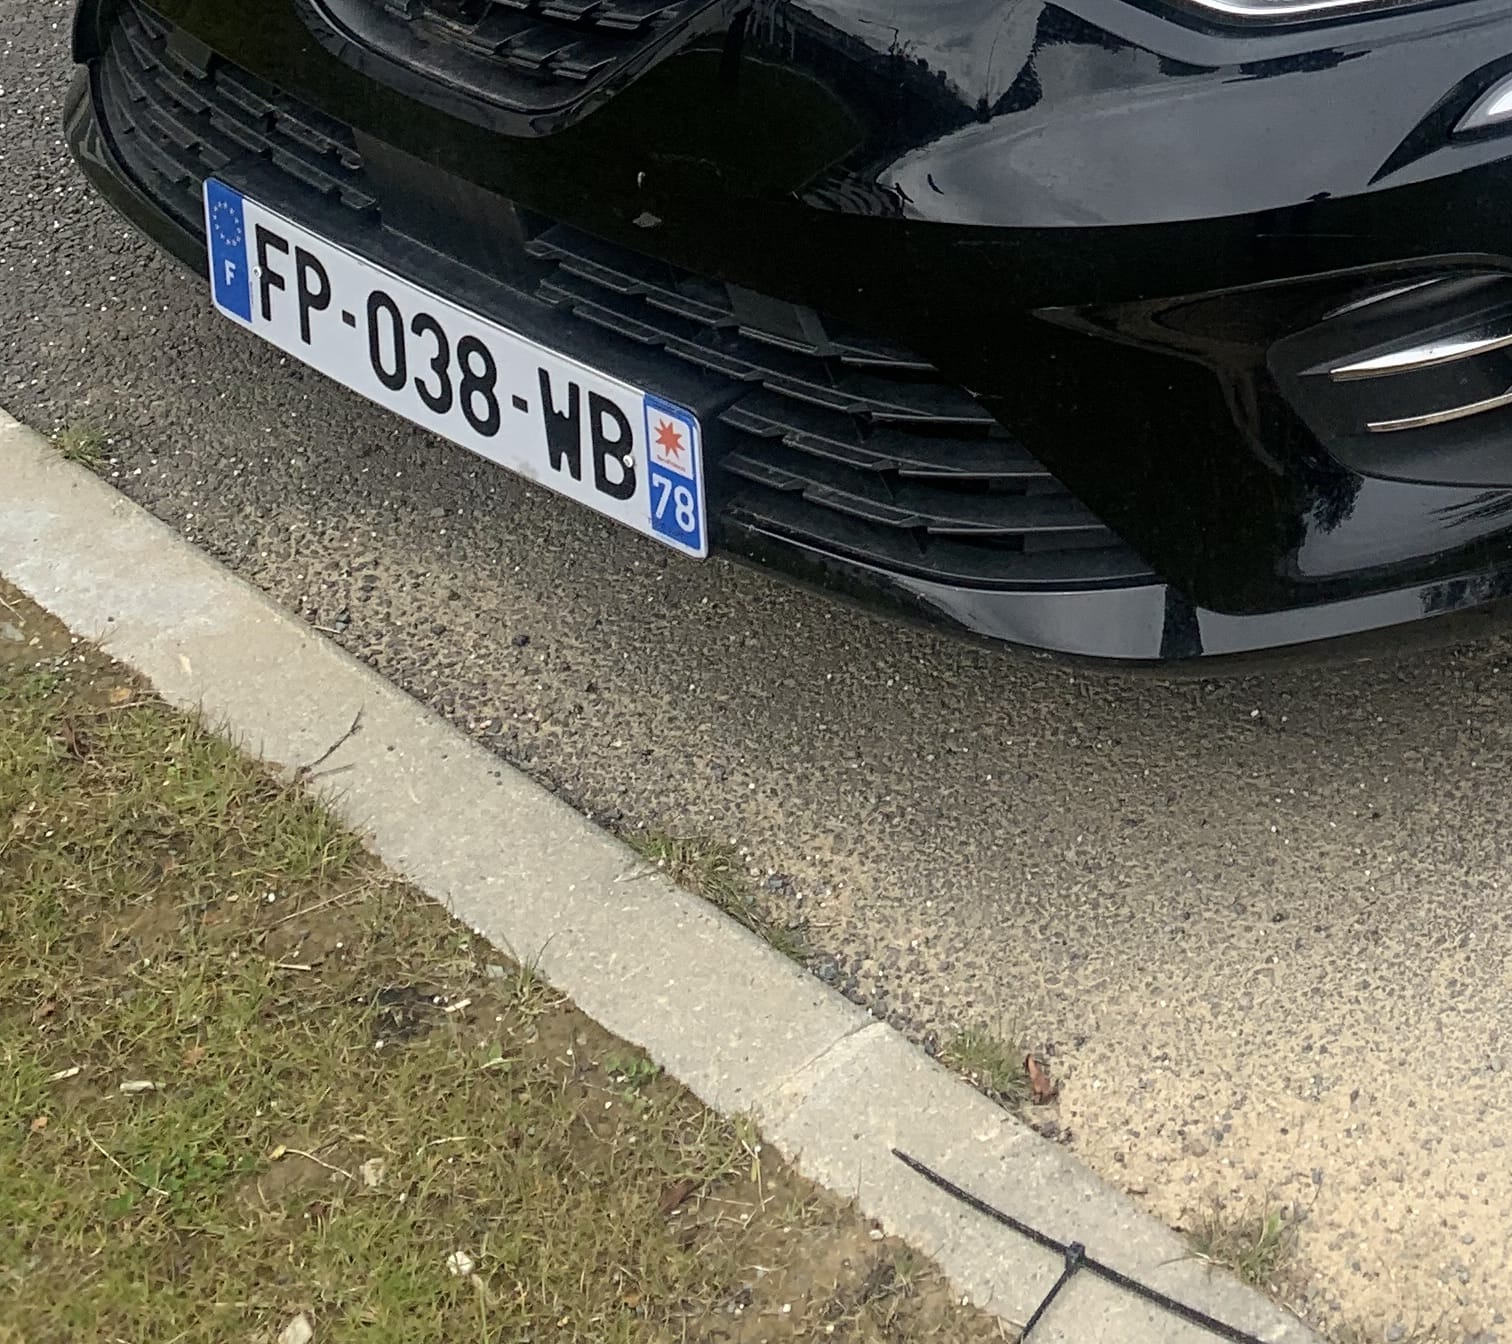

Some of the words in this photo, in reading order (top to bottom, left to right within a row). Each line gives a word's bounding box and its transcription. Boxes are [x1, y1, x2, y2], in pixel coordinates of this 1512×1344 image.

[224, 258, 237, 286] F
[255, 222, 637, 501] FP-038-WB
[652, 472, 696, 533] 78
